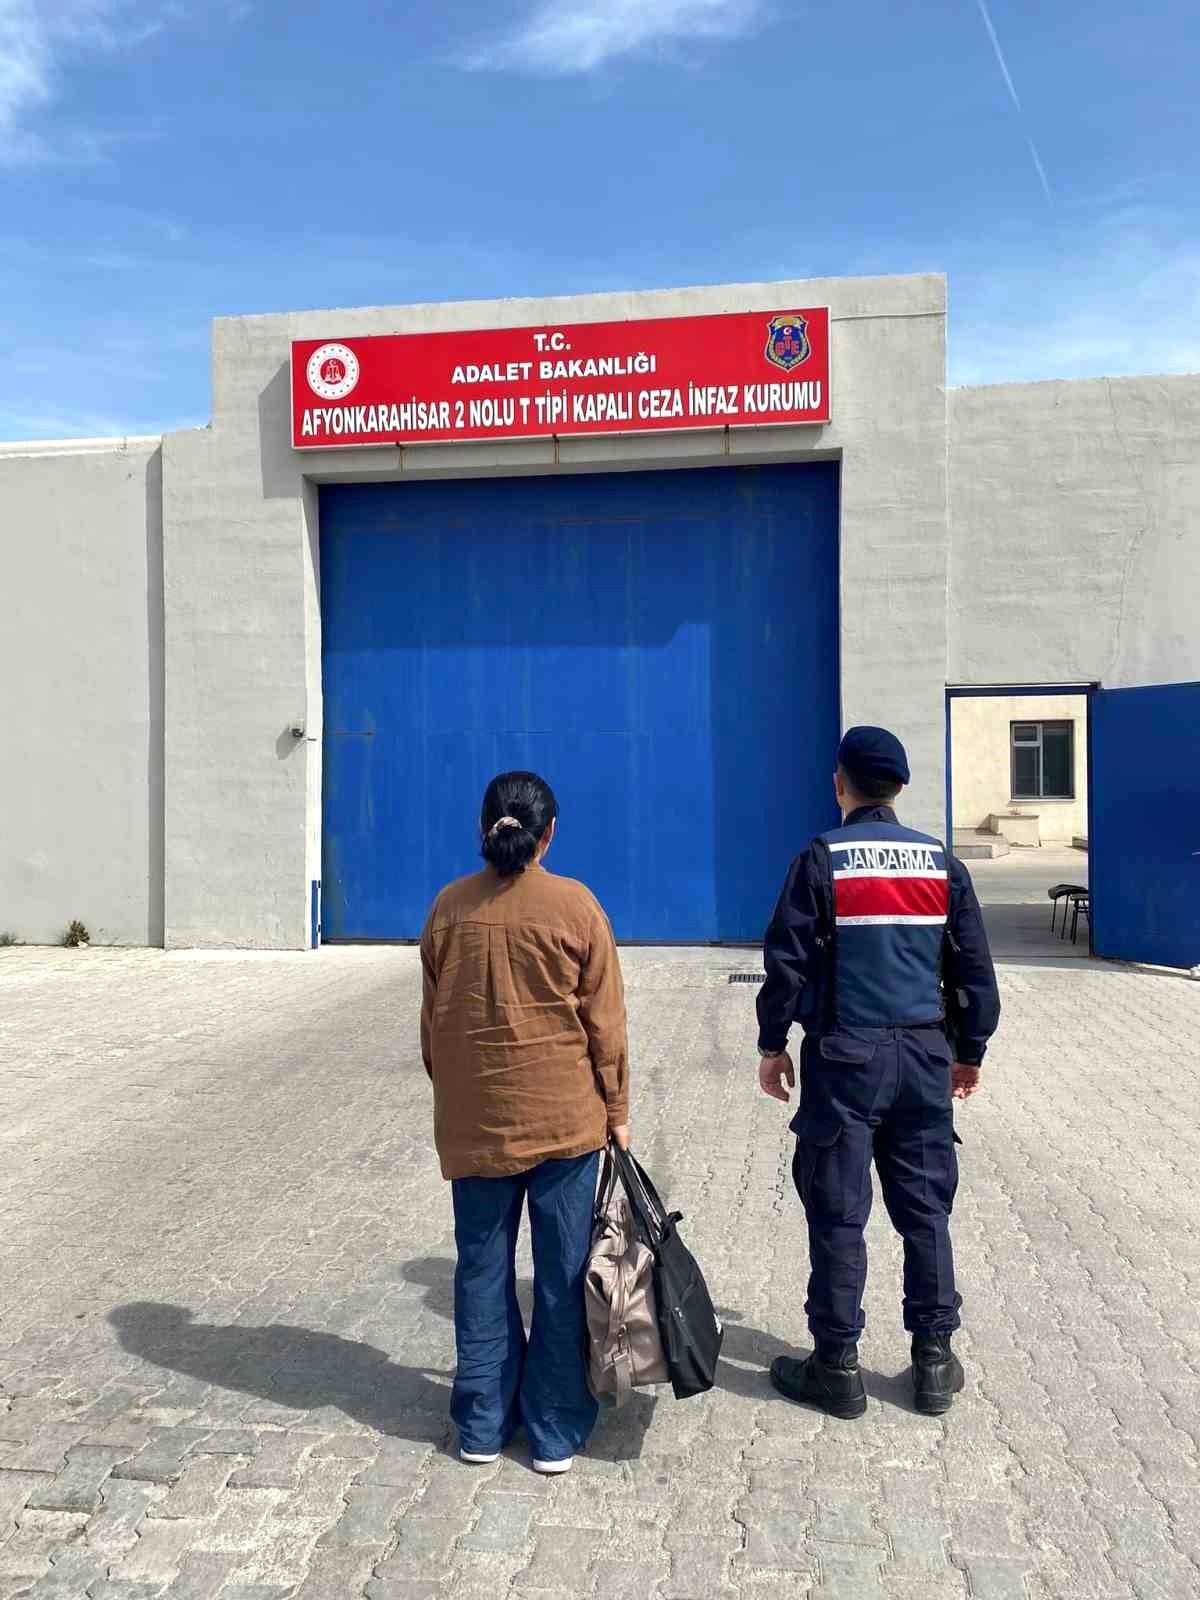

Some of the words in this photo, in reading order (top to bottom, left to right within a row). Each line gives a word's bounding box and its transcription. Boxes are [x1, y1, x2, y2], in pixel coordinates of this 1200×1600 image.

[533, 332, 571, 352] T.C.
[451, 362, 533, 384] ADALET
[539, 352, 657, 379] BAKANLIĞI
[302, 396, 450, 436] AFYONKARAHİSAR
[455, 402, 465, 428] 2
[469, 398, 514, 428] NOLU
[519, 396, 531, 424] T
[535, 389, 568, 424] TİPİ
[573, 391, 633, 423] KAPALI
[638, 387, 683, 419] CEZA
[688, 380, 739, 416] İNFAZ
[744, 380, 822, 413] KURUMU
[842, 847, 937, 871] JANDARMA
